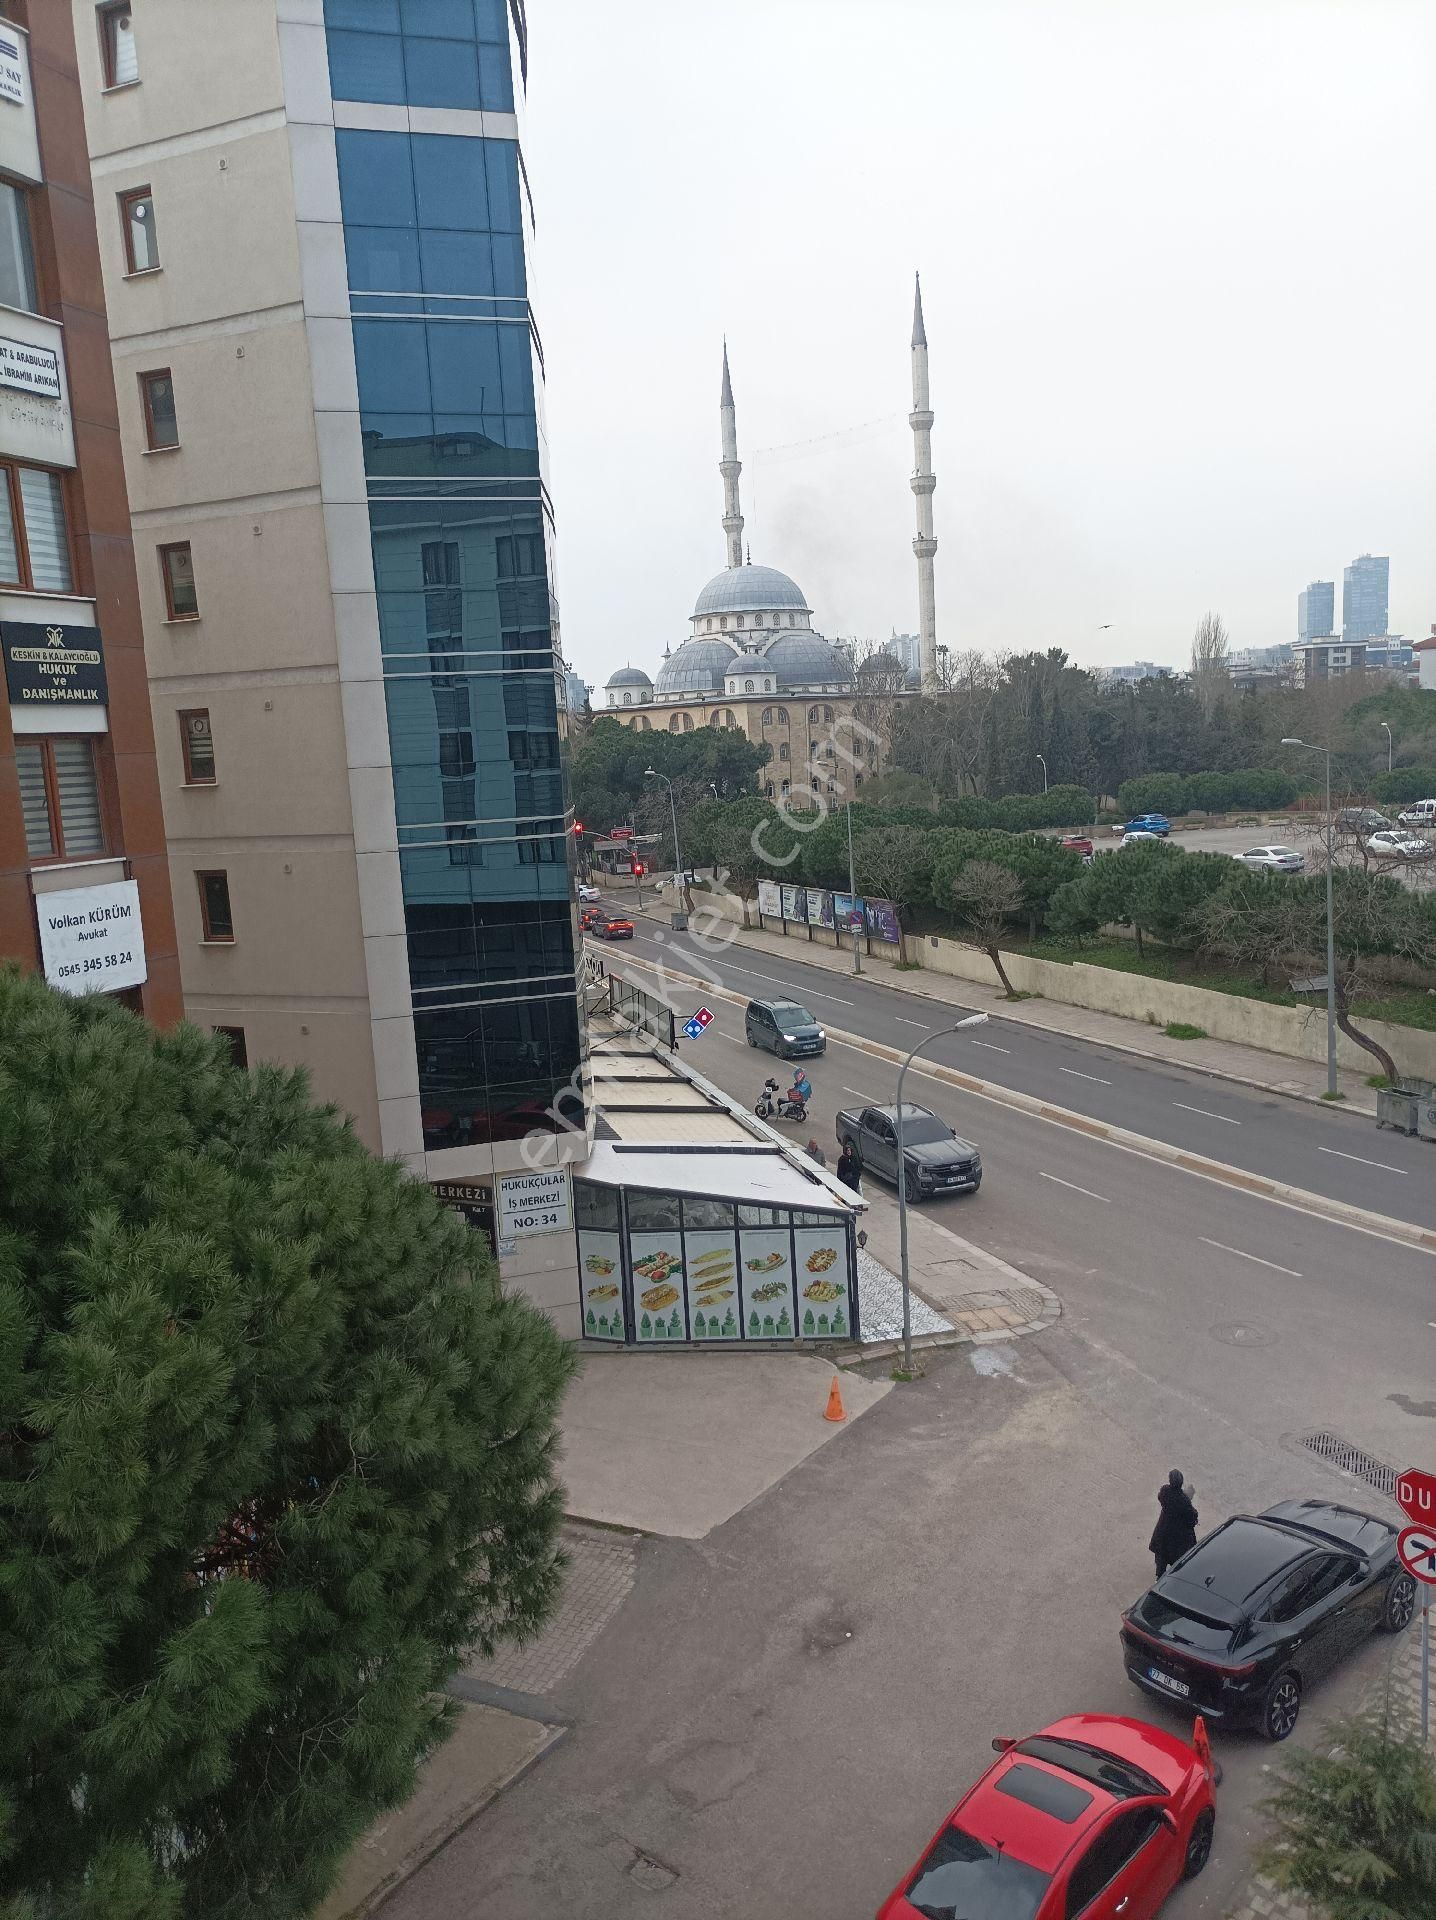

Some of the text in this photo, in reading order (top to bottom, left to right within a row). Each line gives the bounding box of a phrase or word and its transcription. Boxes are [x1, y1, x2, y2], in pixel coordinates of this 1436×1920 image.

[9, 349, 15, 360] &
[16, 351, 55, 370] ARABULUCU
[4, 363, 58, 388] İBRAHİM ARIKAN
[12, 650, 98, 662] KESKİN & KALAYCIOĞLU
[39, 663, 78, 675] HUKUK
[52, 677, 67, 686] ve
[22, 688, 99, 701] DANIŞMANLIK
[48, 904, 132, 930] Volkan KÜRÜM
[78, 927, 108, 942] Avukat
[58, 951, 133, 978] 0545 345 58 24
[501, 1174, 565, 1192] HUKUKÇULAR
[508, 1190, 560, 1210] İŞ MERKEZİ
[513, 1213, 558, 1229] NO: 34
[1401, 1481, 1431, 1510] DU
